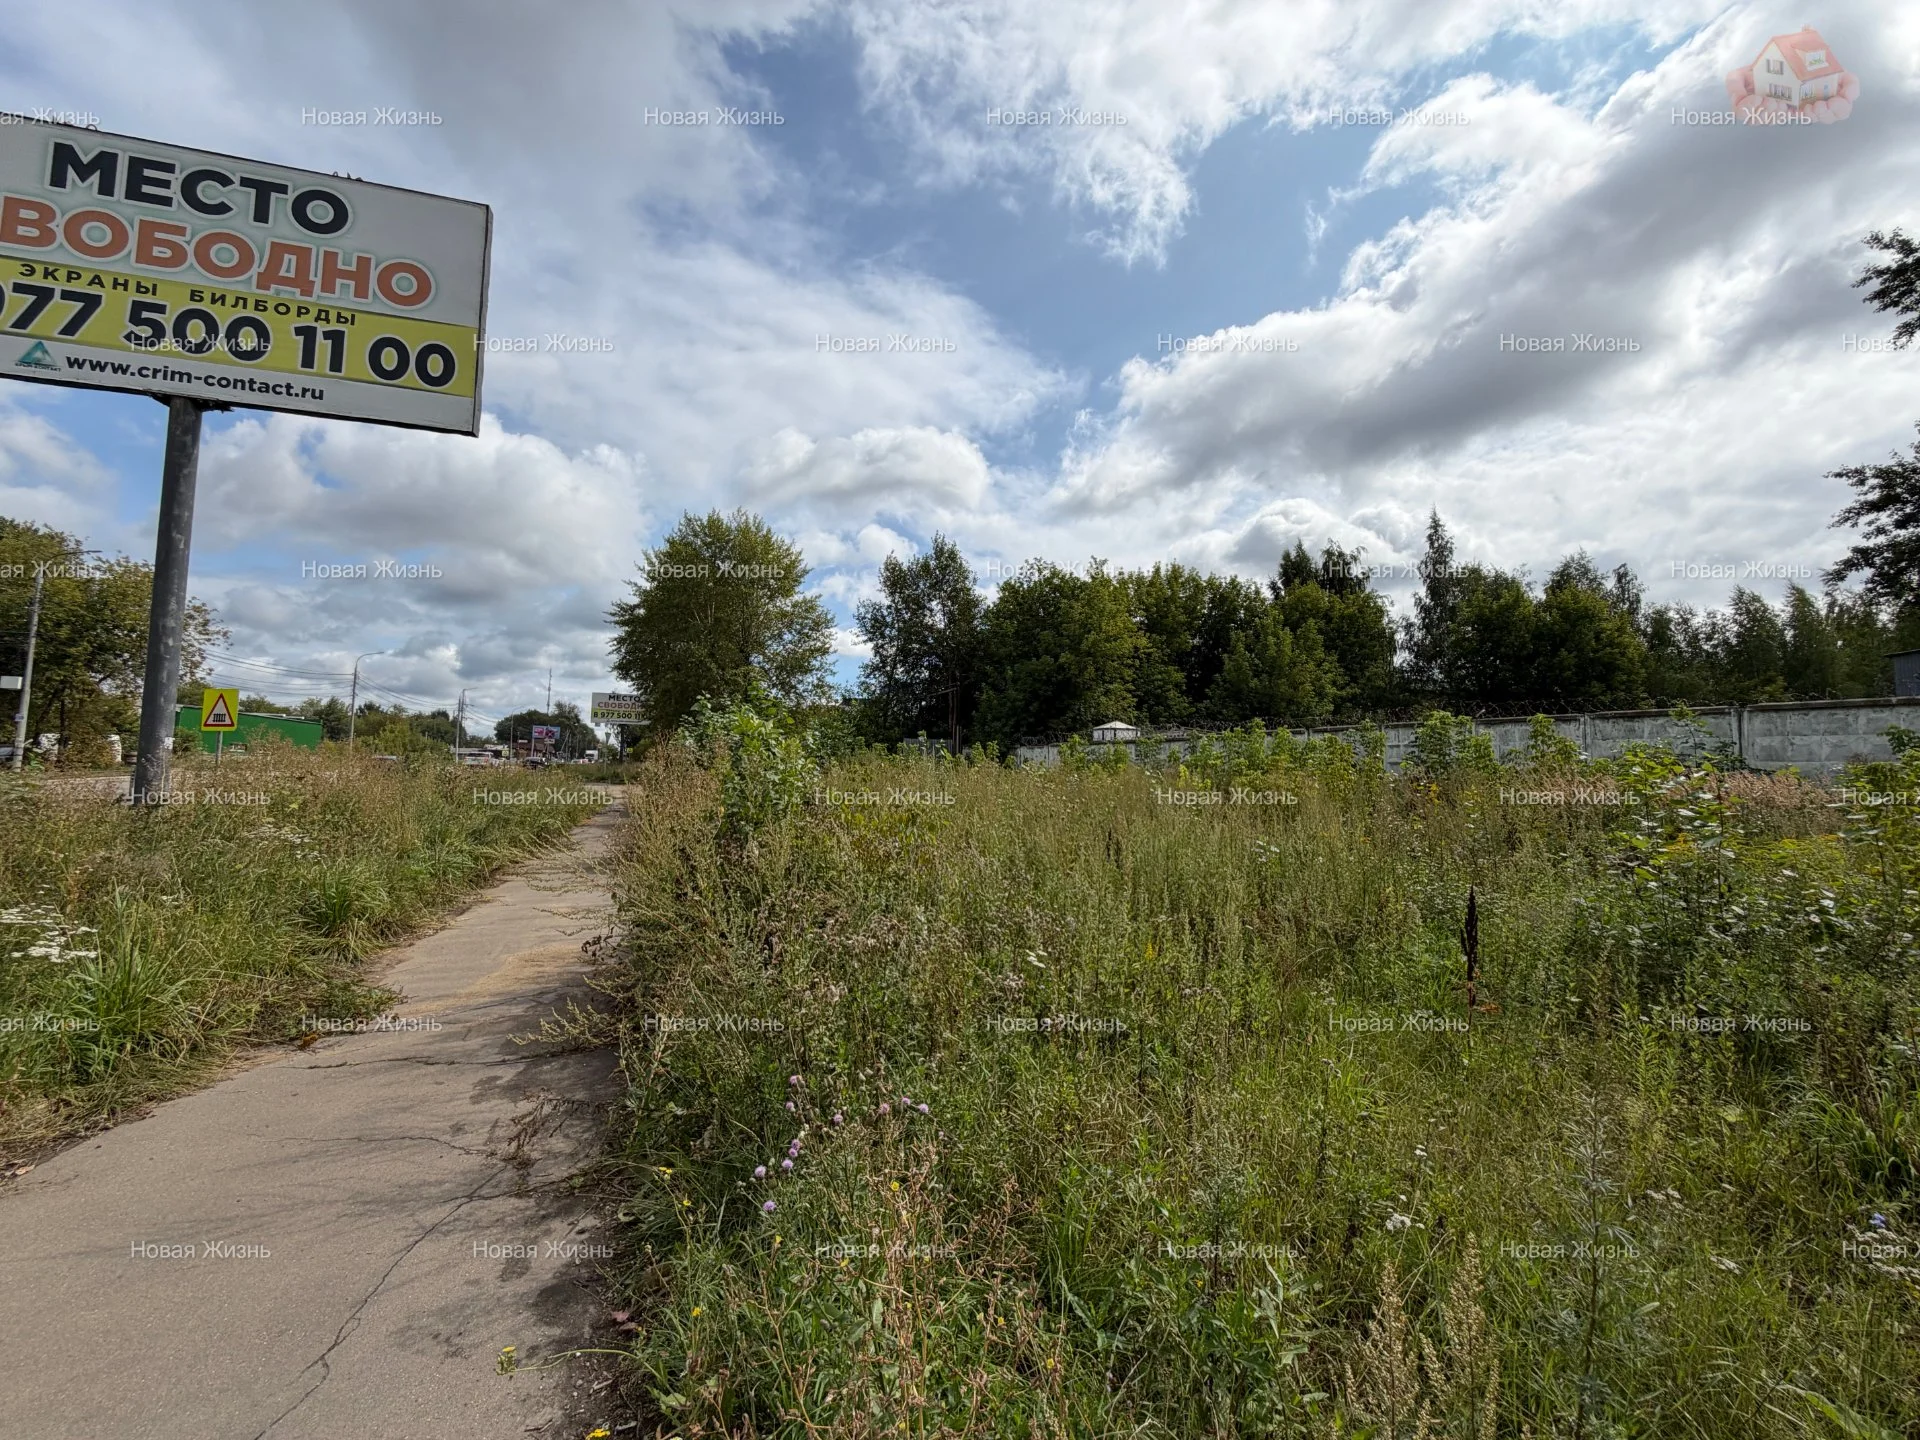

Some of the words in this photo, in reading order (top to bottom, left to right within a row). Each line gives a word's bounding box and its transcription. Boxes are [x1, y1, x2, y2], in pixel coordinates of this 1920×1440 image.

[49, 142, 349, 235] МЕСТО
[19, 263, 157, 296] ЭКРАНЫ
[190, 289, 356, 326] БИЛБОРДЫ
[0, 281, 103, 338] 77
[123, 299, 271, 362] 500
[294, 325, 346, 374] 11
[368, 336, 456, 388] 00
[66, 356, 324, 400] www.crim-contact.ru
[608, 694, 641, 703] МЕСТО
